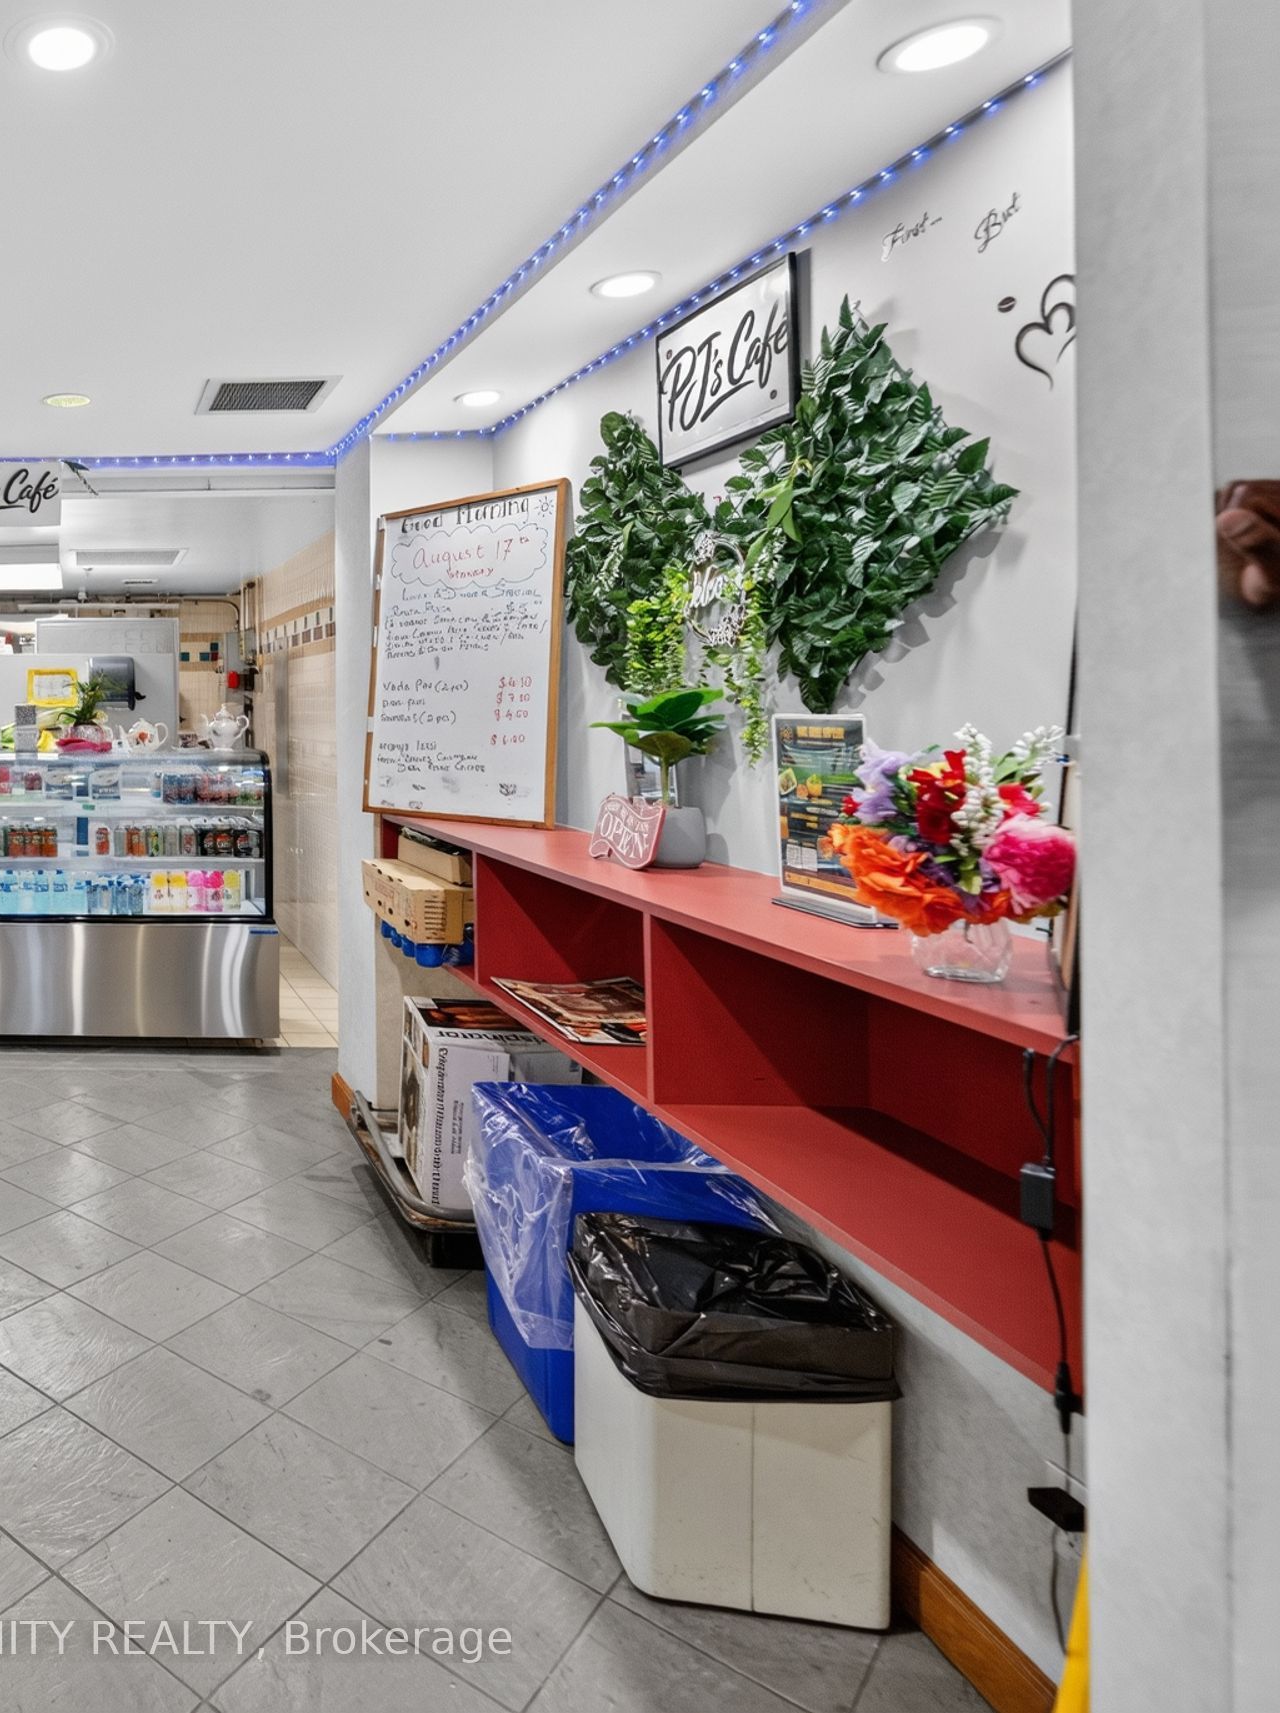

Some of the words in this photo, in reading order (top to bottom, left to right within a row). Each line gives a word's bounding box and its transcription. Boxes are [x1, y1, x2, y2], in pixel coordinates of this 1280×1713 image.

[660, 331, 724, 432] PJ's
[727, 299, 788, 389] Café
[3, 468, 60, 514] Café
[600, 811, 649, 859] OPEN
